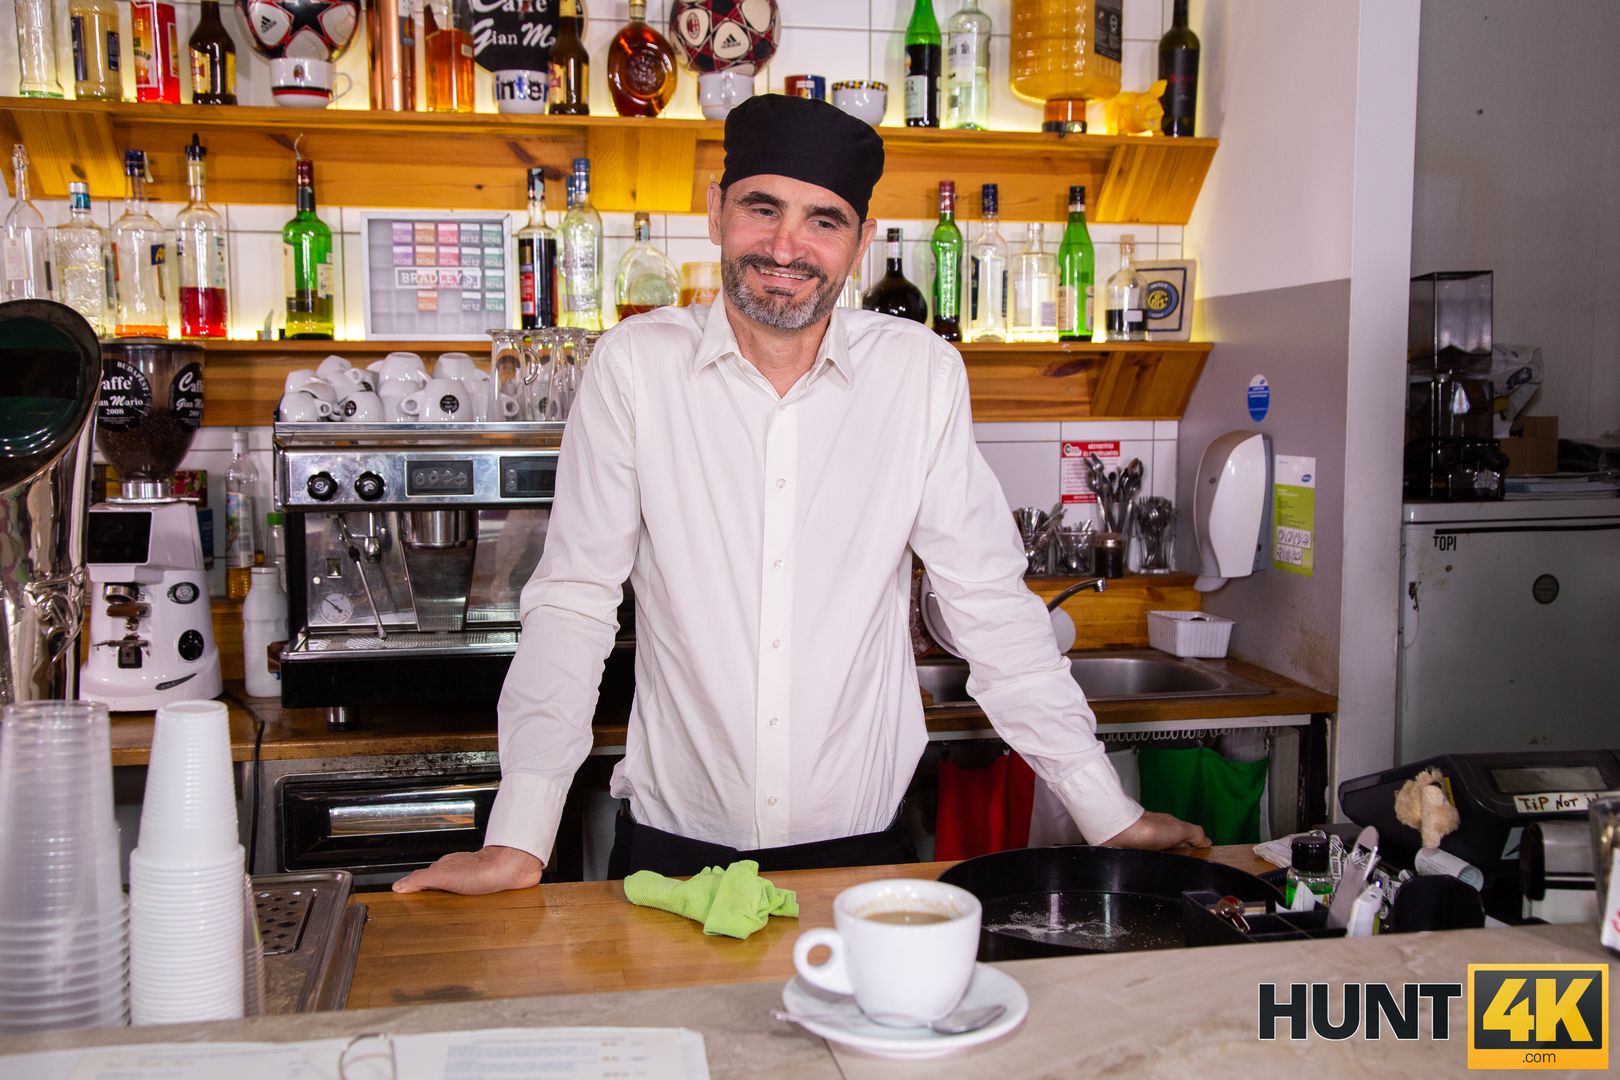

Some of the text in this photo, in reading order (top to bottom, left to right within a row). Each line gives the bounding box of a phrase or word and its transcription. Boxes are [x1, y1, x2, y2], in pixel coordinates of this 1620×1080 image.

[109, 395, 144, 408] Mario
[106, 407, 125, 416] 2008
[1433, 535, 1457, 551] TOPI
